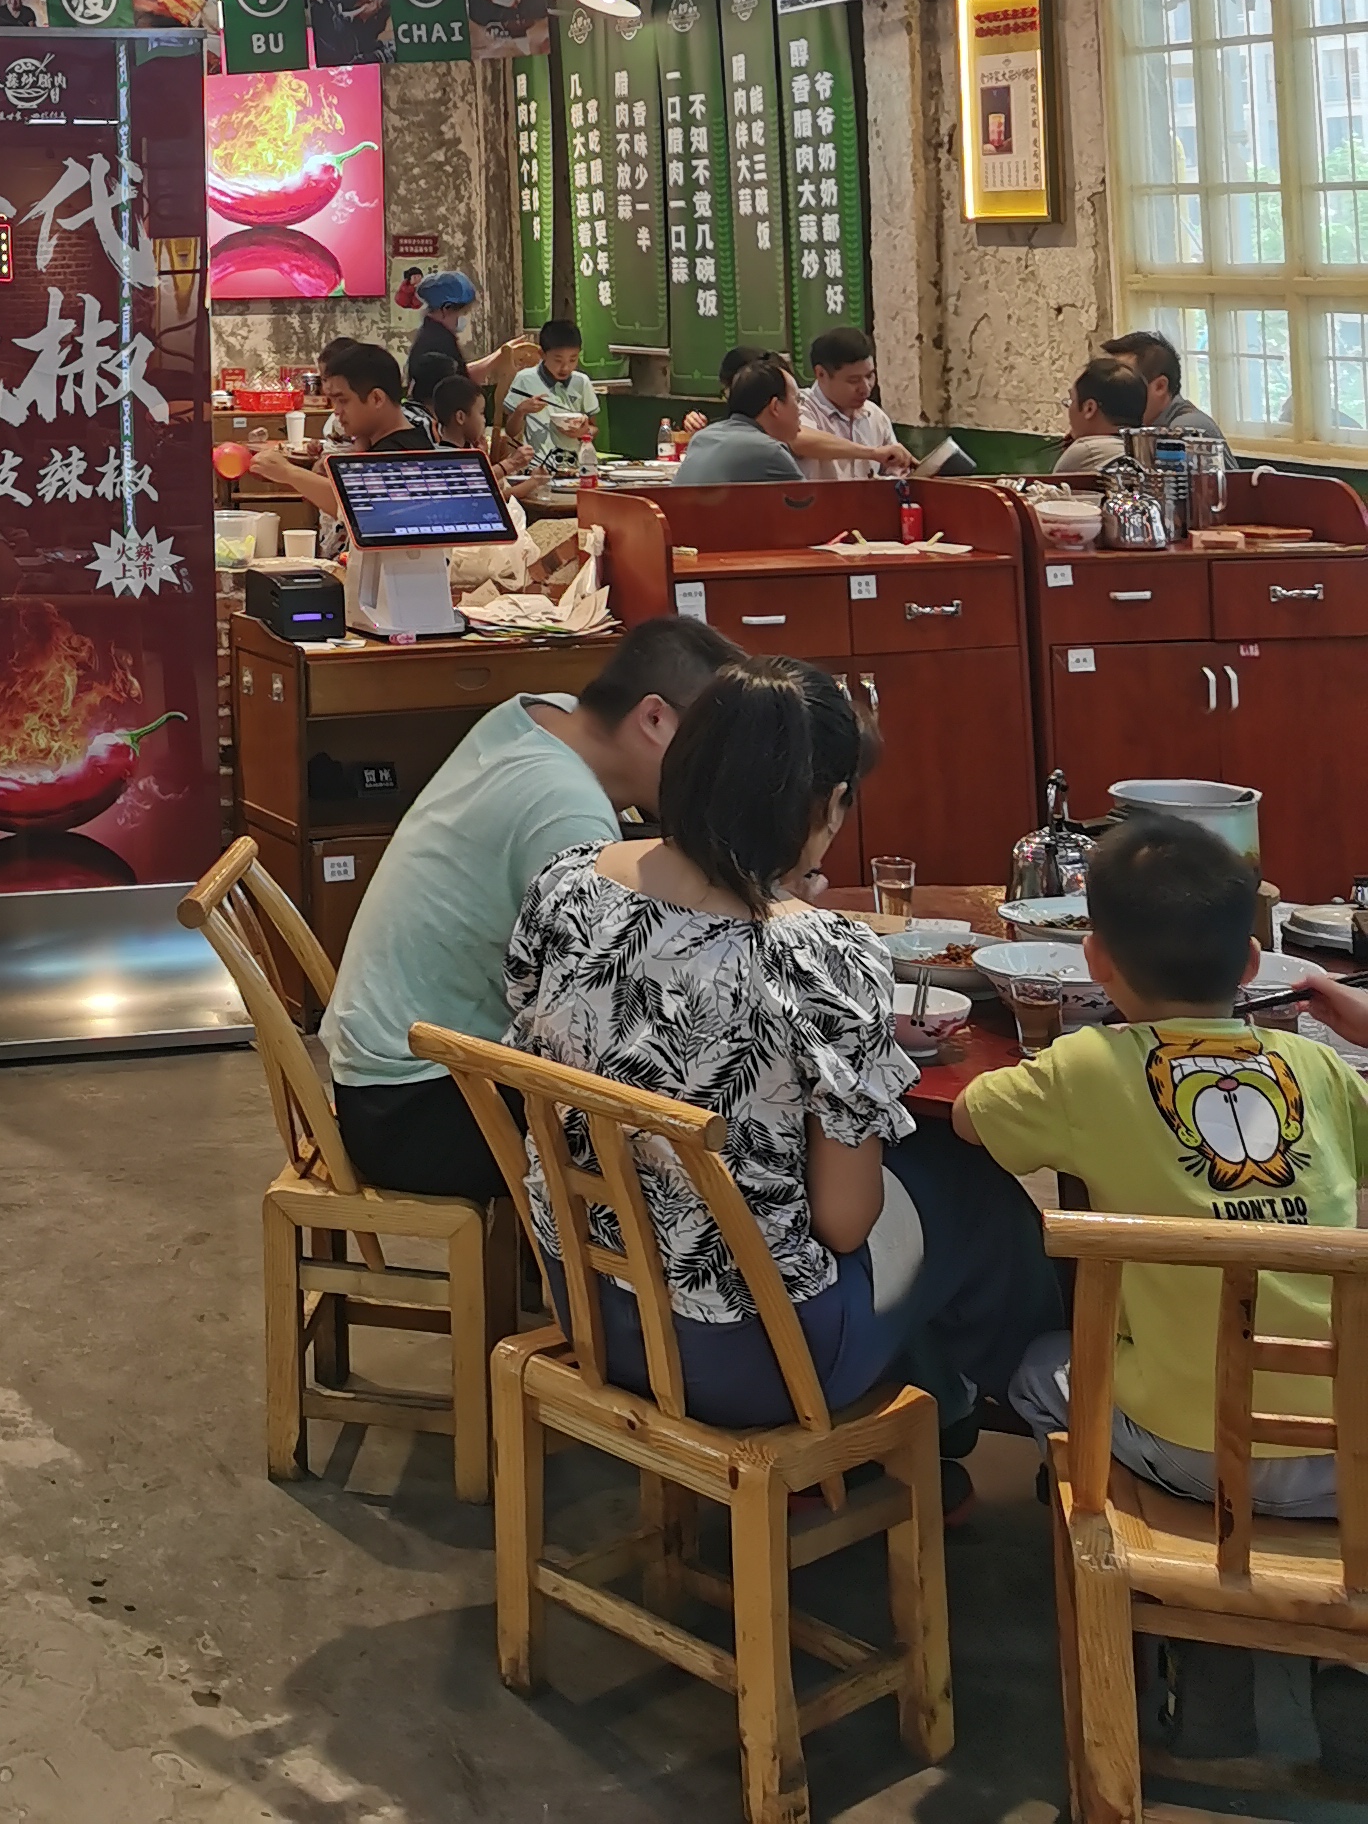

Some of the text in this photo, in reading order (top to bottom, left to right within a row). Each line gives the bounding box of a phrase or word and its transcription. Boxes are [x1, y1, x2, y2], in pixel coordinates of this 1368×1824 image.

[251, 33, 284, 54] BU
[397, 22, 463, 45] CHAI
[516, 73, 533, 214] 腊肉是个宝
[569, 73, 595, 278] 几根大蒜连着心
[586, 98, 613, 308] 常吃腊肉更年轻
[615, 71, 634, 223] 腊肉不放蒜
[632, 101, 652, 254] 香味少一半
[666, 70, 691, 285] 一口腊肉一口蒜
[688, 93, 718, 318] 不知不觉几碗饭
[731, 53, 754, 217] 腊肉伴大蒜
[749, 85, 771, 251] 能吃三碗饭
[788, 39, 821, 280] 醇香腊肉大蒜炒
[814, 71, 846, 316] 爷爷奶奶都说好
[114, 542, 156, 563] 火辣
[114, 561, 156, 580] 上市
[1212, 1201, 1222, 1220] I
[1224, 1198, 1278, 1221] DON'T
[1282, 1196, 1308, 1216] DO
